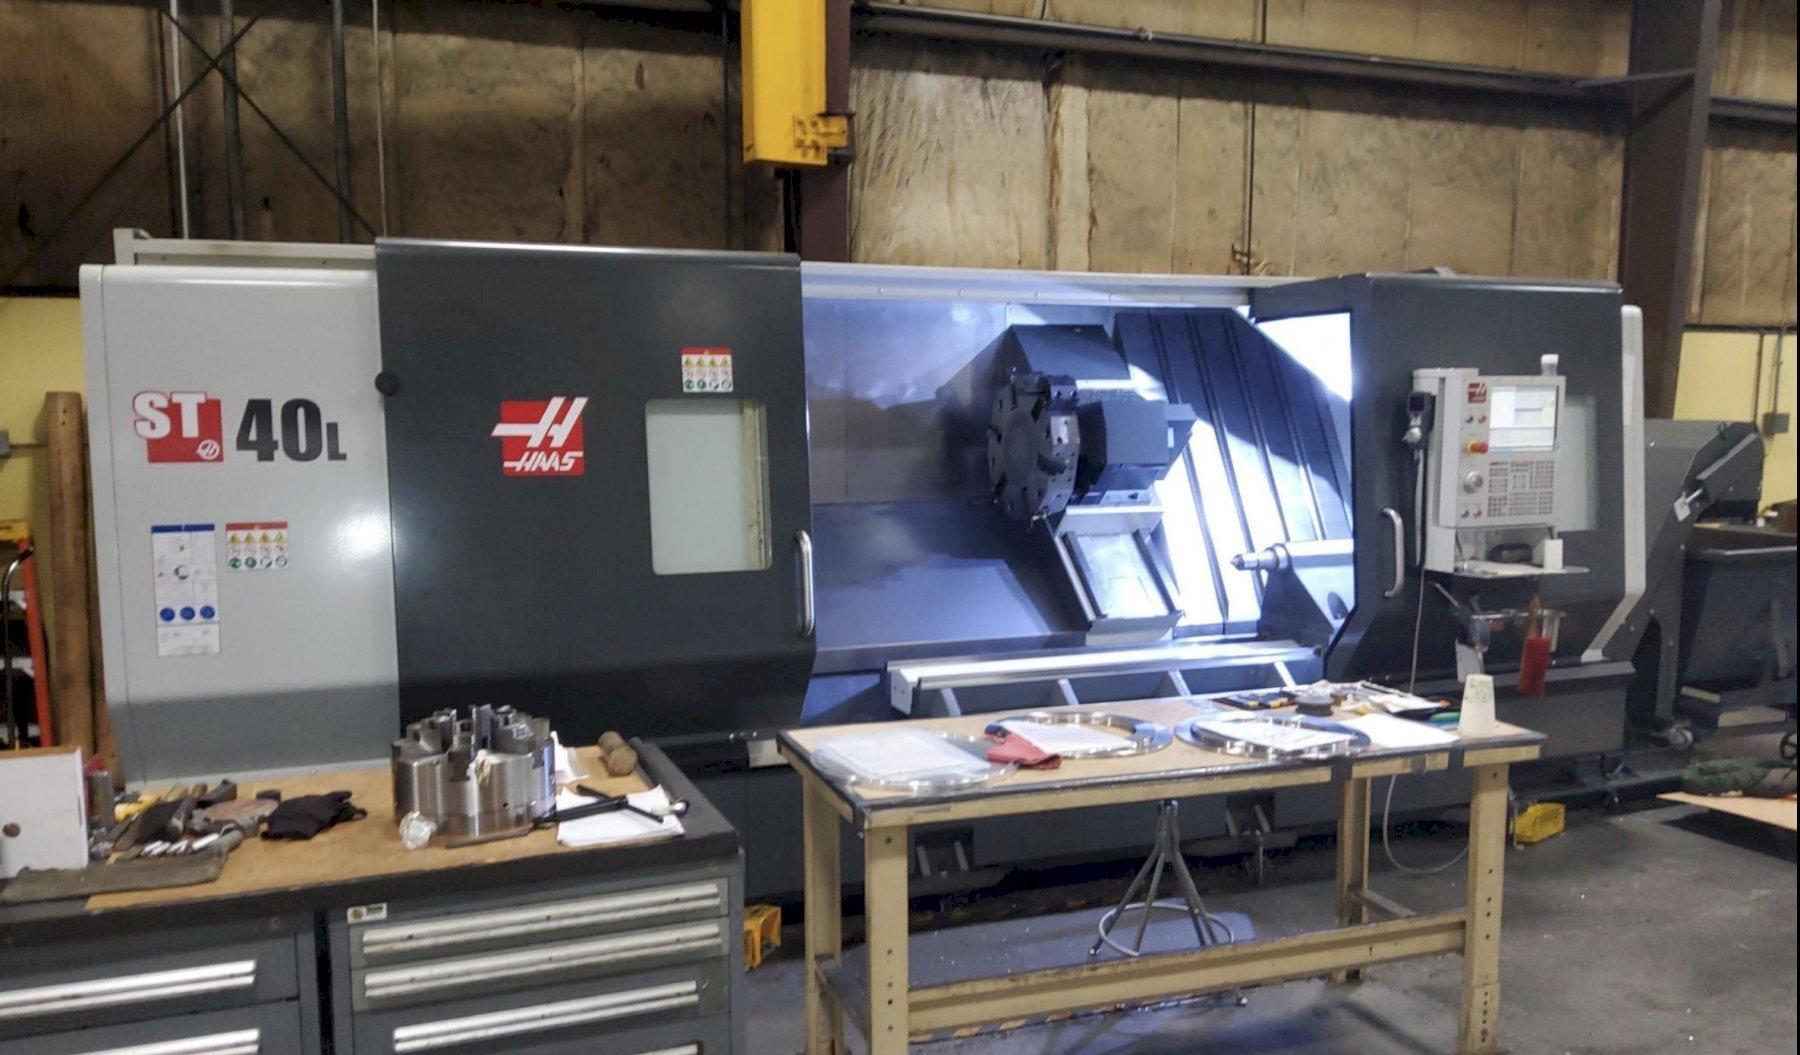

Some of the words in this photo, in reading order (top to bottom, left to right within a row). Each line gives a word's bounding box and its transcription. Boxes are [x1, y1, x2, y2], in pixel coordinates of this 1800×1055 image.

[133, 390, 207, 439] ST
[236, 398, 347, 462] 40L
[503, 450, 584, 472] HAAS
